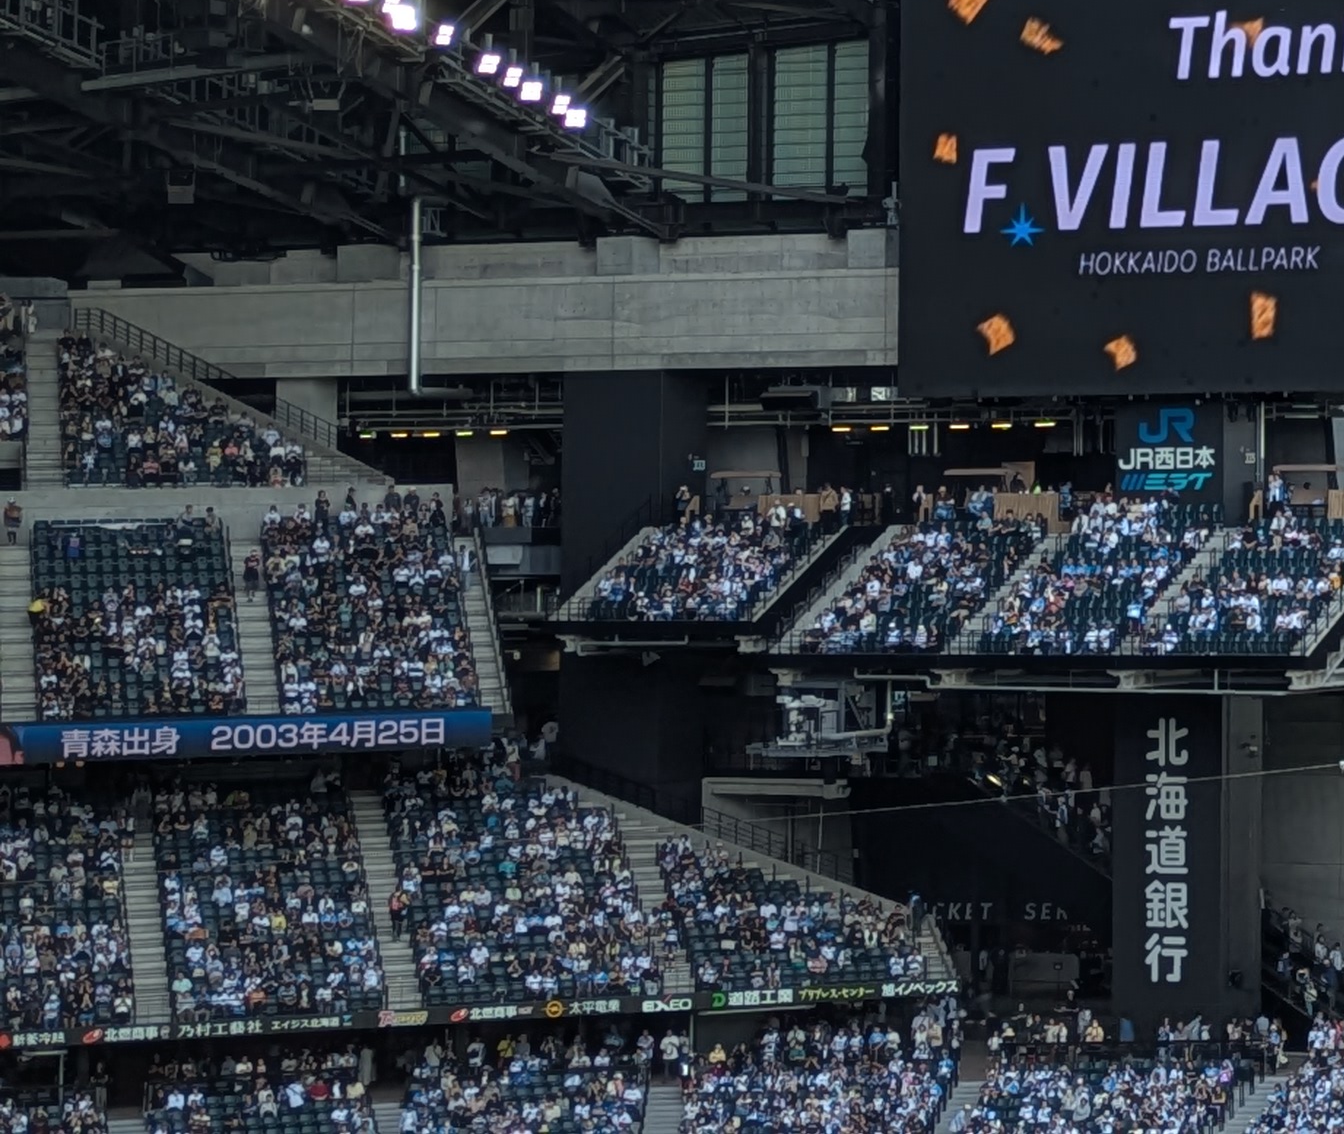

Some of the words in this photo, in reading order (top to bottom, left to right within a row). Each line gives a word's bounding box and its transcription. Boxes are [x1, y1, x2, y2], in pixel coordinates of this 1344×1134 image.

[964, 148, 1015, 233] F
[1079, 249, 1198, 276] HOKKAIDO
[1205, 246, 1320, 273] BALLPARK
[1139, 408, 1194, 443] JR
[1118, 446, 1215, 470] JR西日本
[60, 728, 181, 759] 青森出身
[210, 717, 446, 752] 2003年4月25日
[1144, 717, 1189, 984] 北海道銀行
[642, 994, 692, 1012] EXEO
